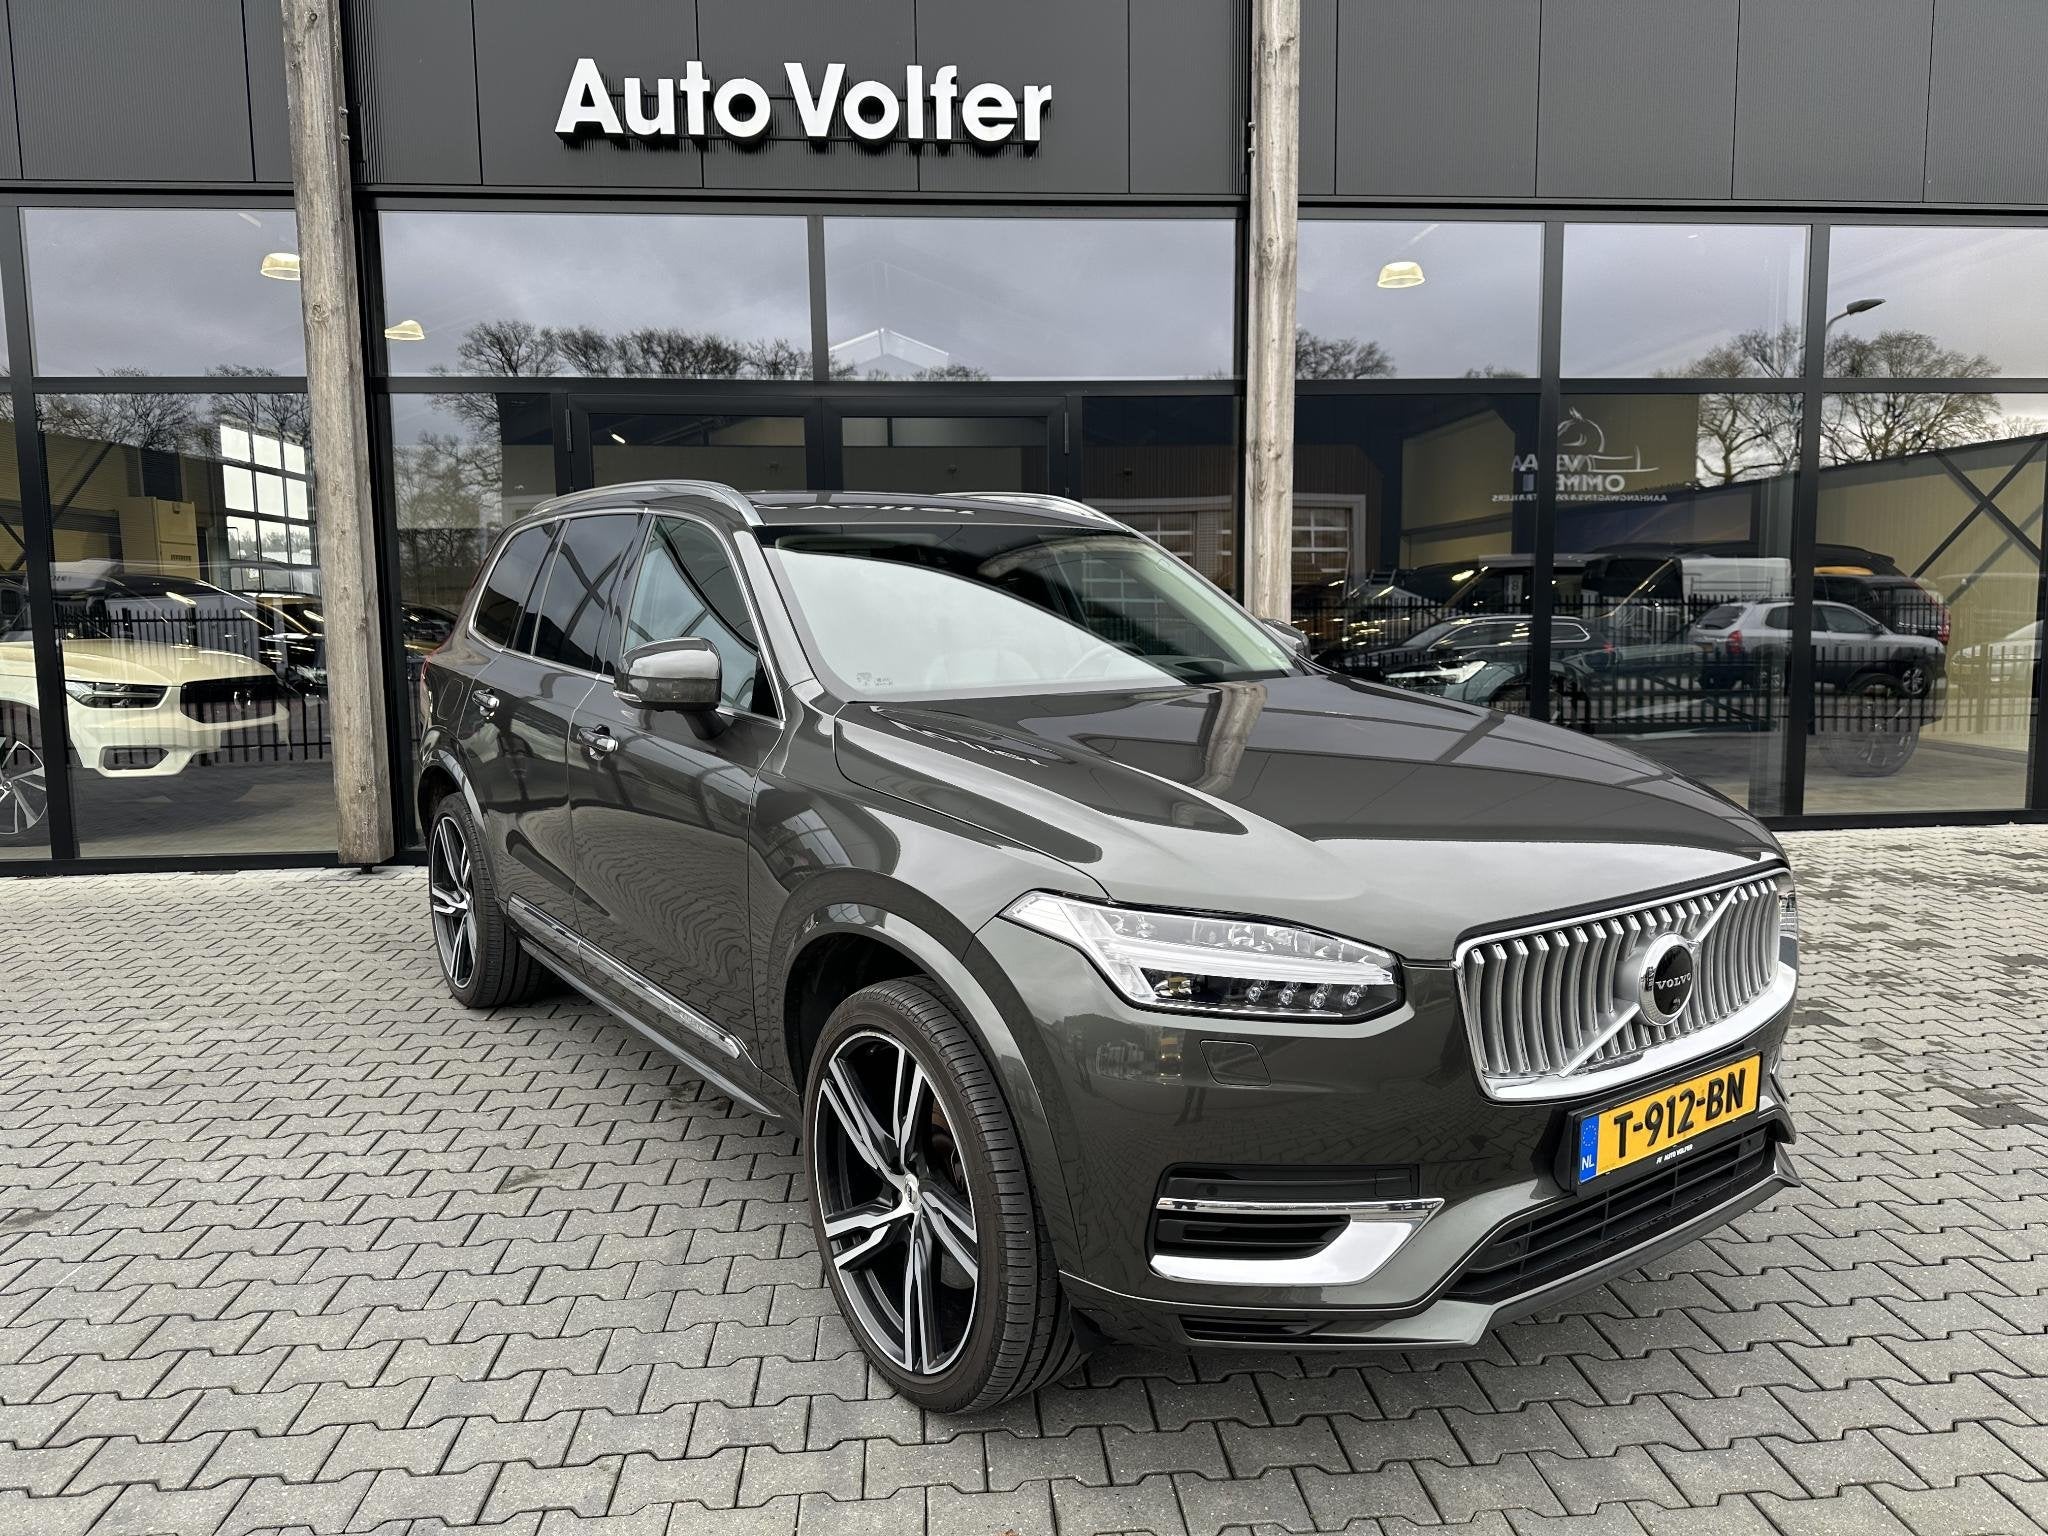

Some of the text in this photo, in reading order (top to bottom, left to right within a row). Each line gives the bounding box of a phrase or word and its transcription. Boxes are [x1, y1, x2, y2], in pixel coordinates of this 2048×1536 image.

[554, 57, 1053, 142] Auto Volfer
[1655, 972, 1692, 990] VOLVO
[1613, 1067, 1746, 1159] T-912-BN
[1581, 1154, 1595, 1171] NL
